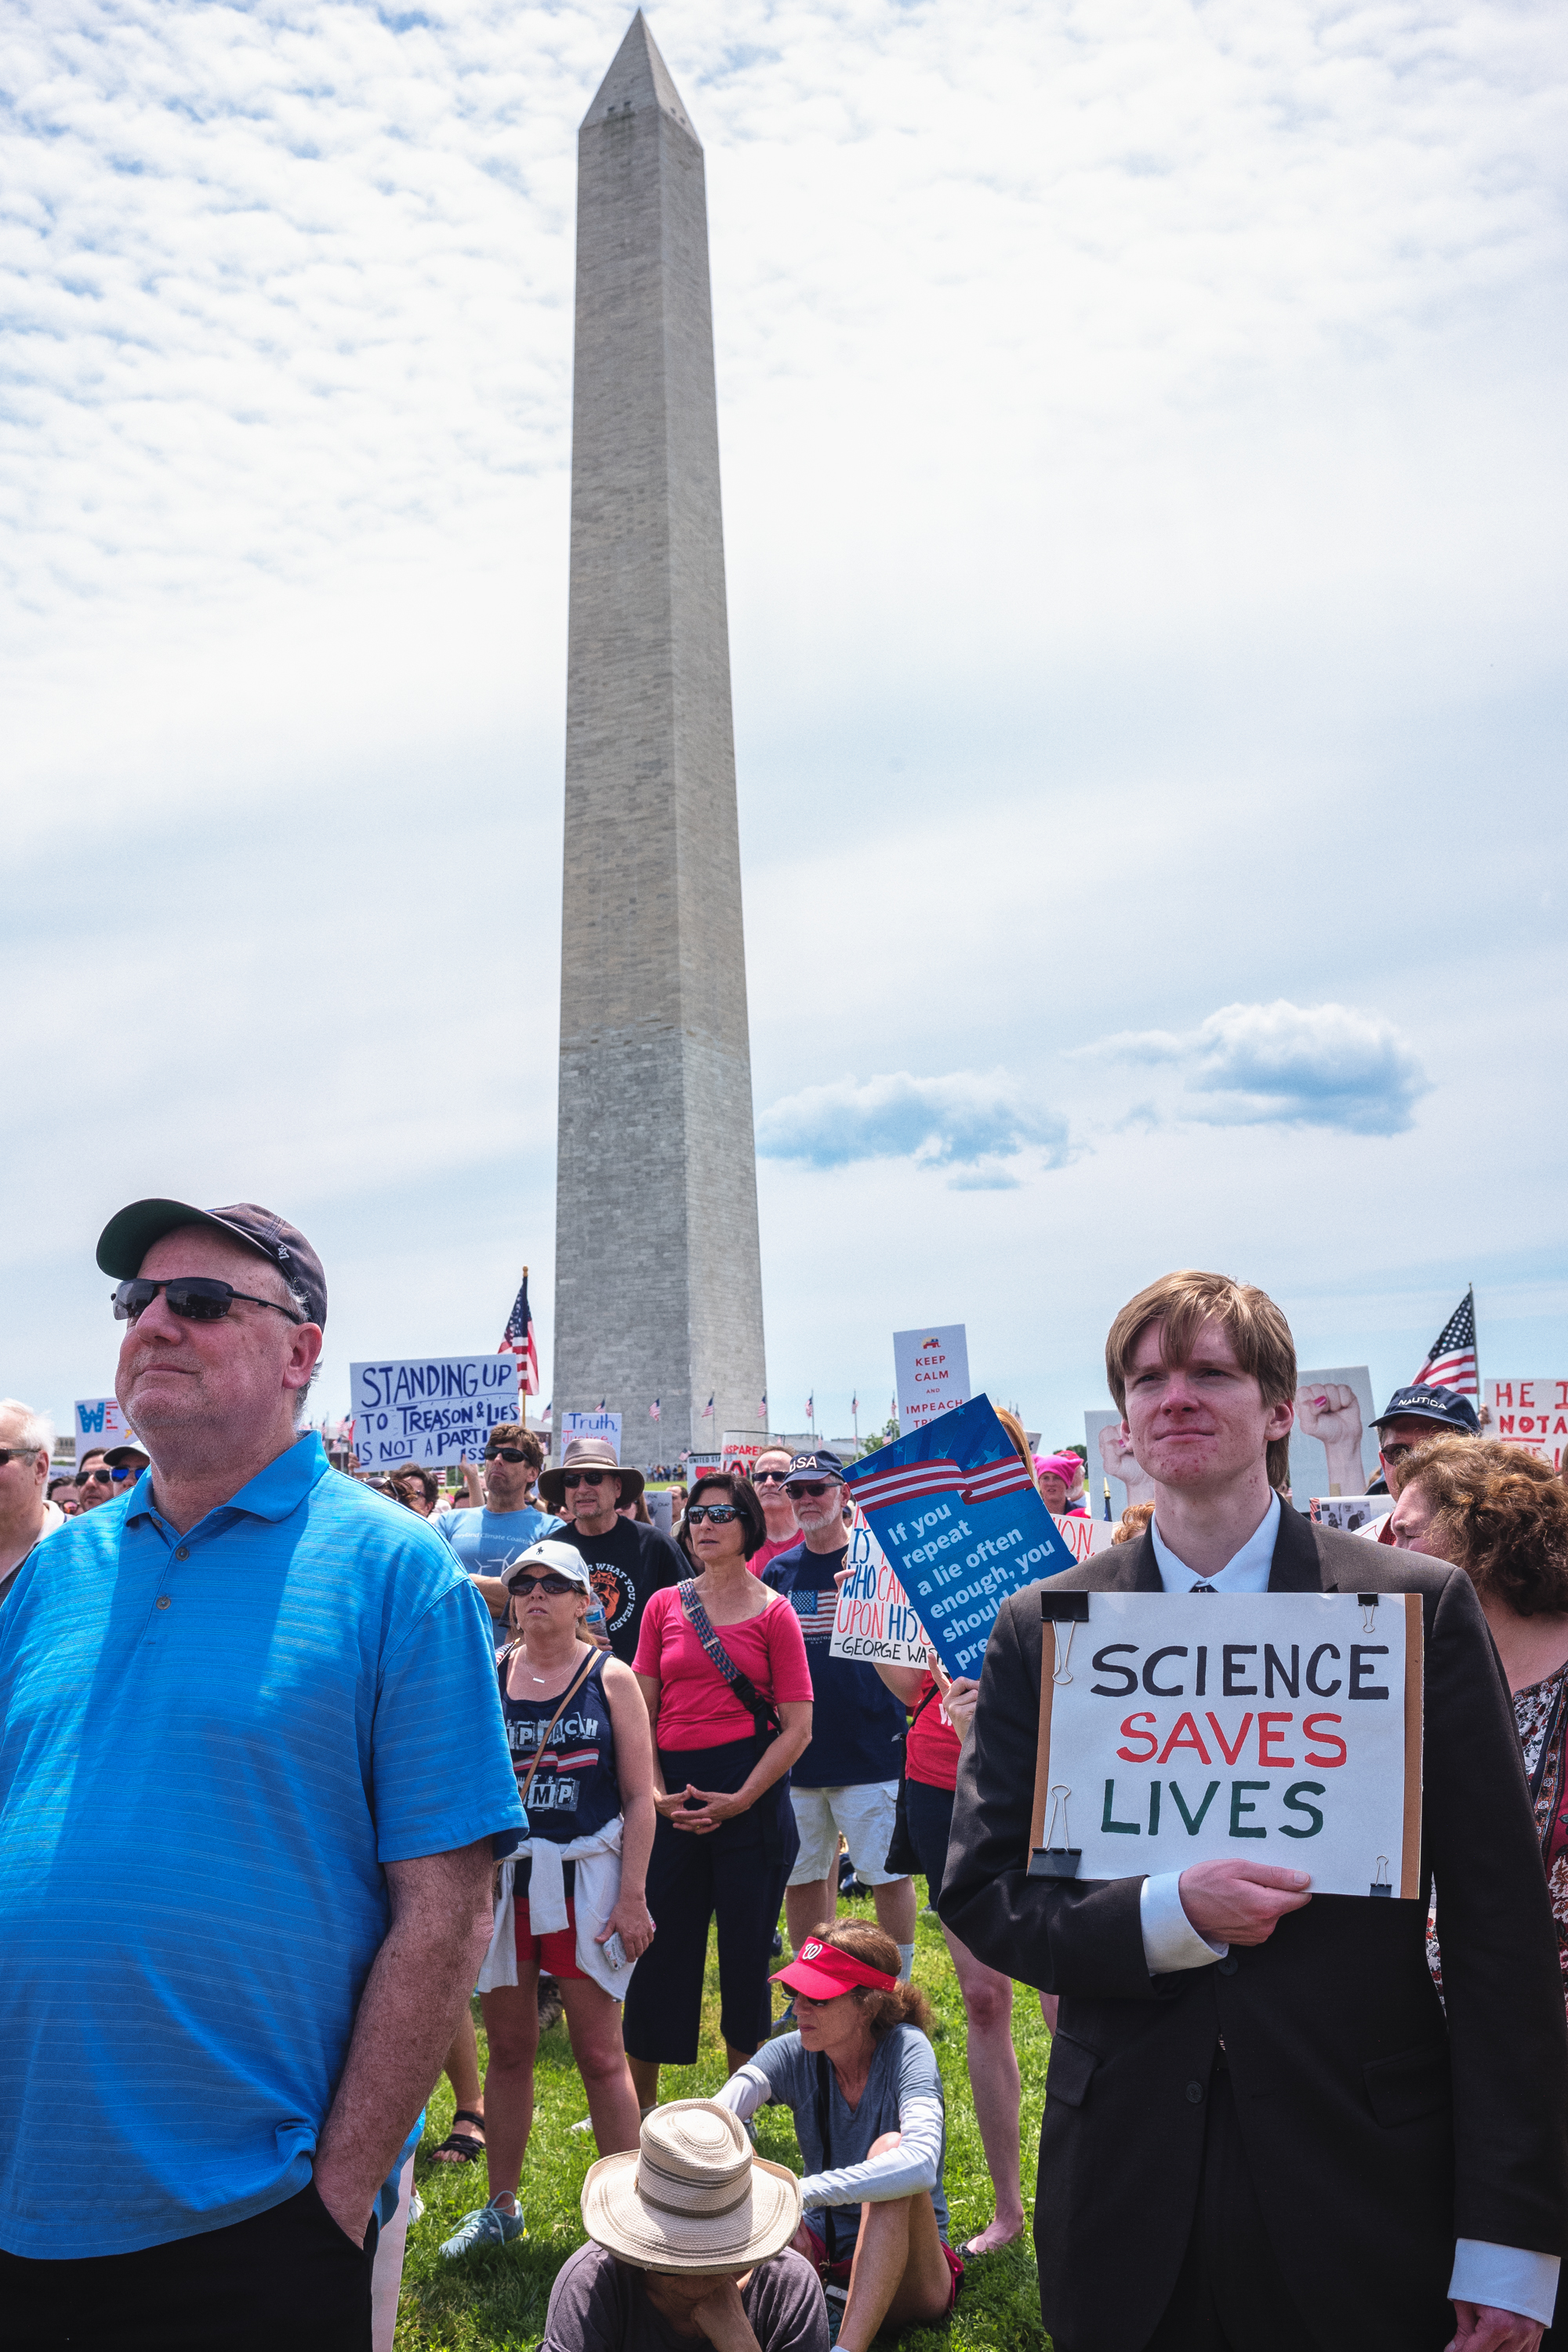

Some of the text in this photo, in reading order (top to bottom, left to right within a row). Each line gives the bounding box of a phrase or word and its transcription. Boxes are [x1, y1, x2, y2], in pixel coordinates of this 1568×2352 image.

[915, 1355, 946, 1367] KEEP
[361, 1362, 512, 1408] STANDING UP
[914, 1370, 949, 1382] CALM
[906, 1399, 963, 1414] IMPEACH
[1398, 1396, 1448, 1410] NAUTICA
[1496, 1381, 1535, 1407] HE
[361, 1401, 518, 1436] TO TREASON & LIES
[568, 1412, 619, 1432] Truth,
[913, 1418, 937, 1428] TR
[1499, 1414, 1550, 1434] NOT
[355, 1441, 372, 1462] IS
[379, 1438, 418, 1459] NOT
[424, 1438, 433, 1457] A
[789, 1455, 818, 1473] USA
[887, 1503, 952, 1546] If you
[850, 1528, 871, 1564] IS
[902, 1519, 973, 1569] repeat
[595, 1563, 628, 1579] WHAT
[916, 1528, 1024, 1596] a lie often
[624, 1578, 636, 1601] YOU
[842, 1564, 877, 1600] WHO
[930, 1539, 1055, 1619] enough, you
[609, 1602, 635, 1632] HEARD
[837, 1599, 884, 1639] UPON
[888, 1603, 918, 1643] HIS
[834, 1636, 902, 1661] -GEORGE
[1090, 1642, 1390, 1700] SCIENCE
[1116, 1711, 1348, 1768] SAVES
[1100, 1778, 1327, 1838] LIVES
[802, 1943, 823, 1960] W
